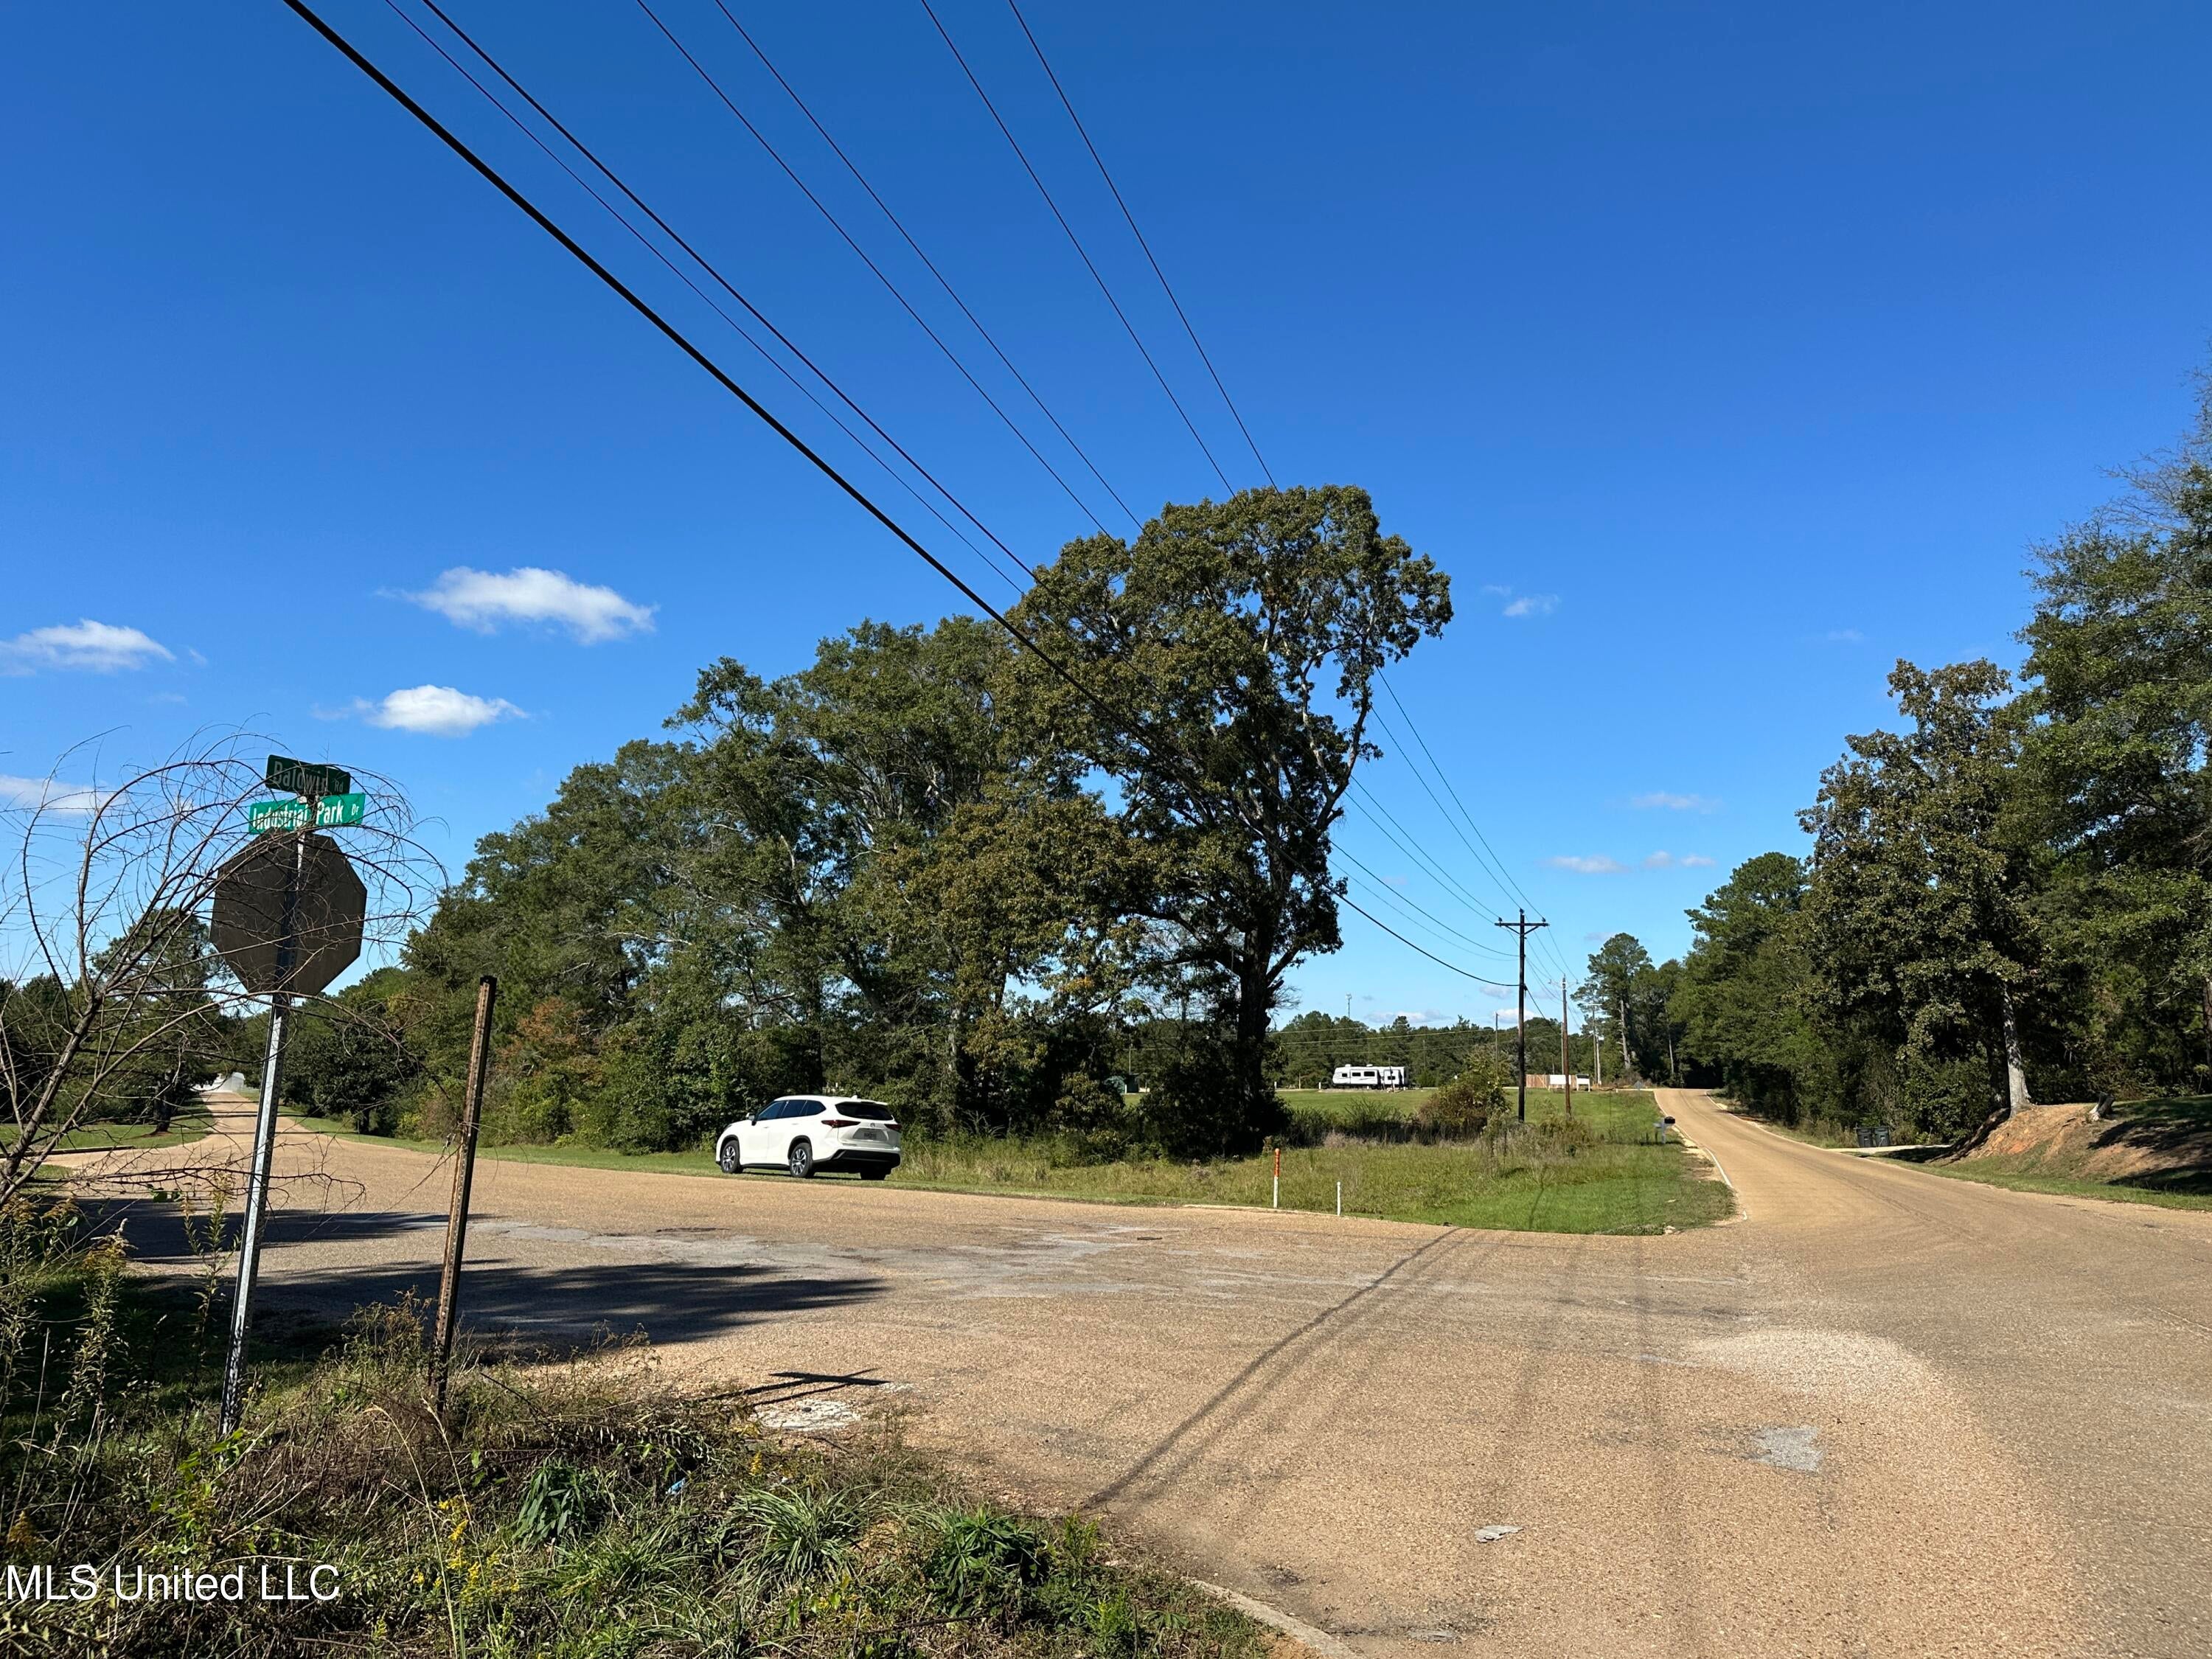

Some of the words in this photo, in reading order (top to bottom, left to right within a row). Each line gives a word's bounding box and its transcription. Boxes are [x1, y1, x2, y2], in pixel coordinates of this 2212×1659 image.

[273, 761, 329, 793] Baldwin
[334, 780, 344, 793] Rd
[252, 804, 309, 830] Industrial
[315, 800, 344, 826] Park
[351, 804, 360, 816] Dr
